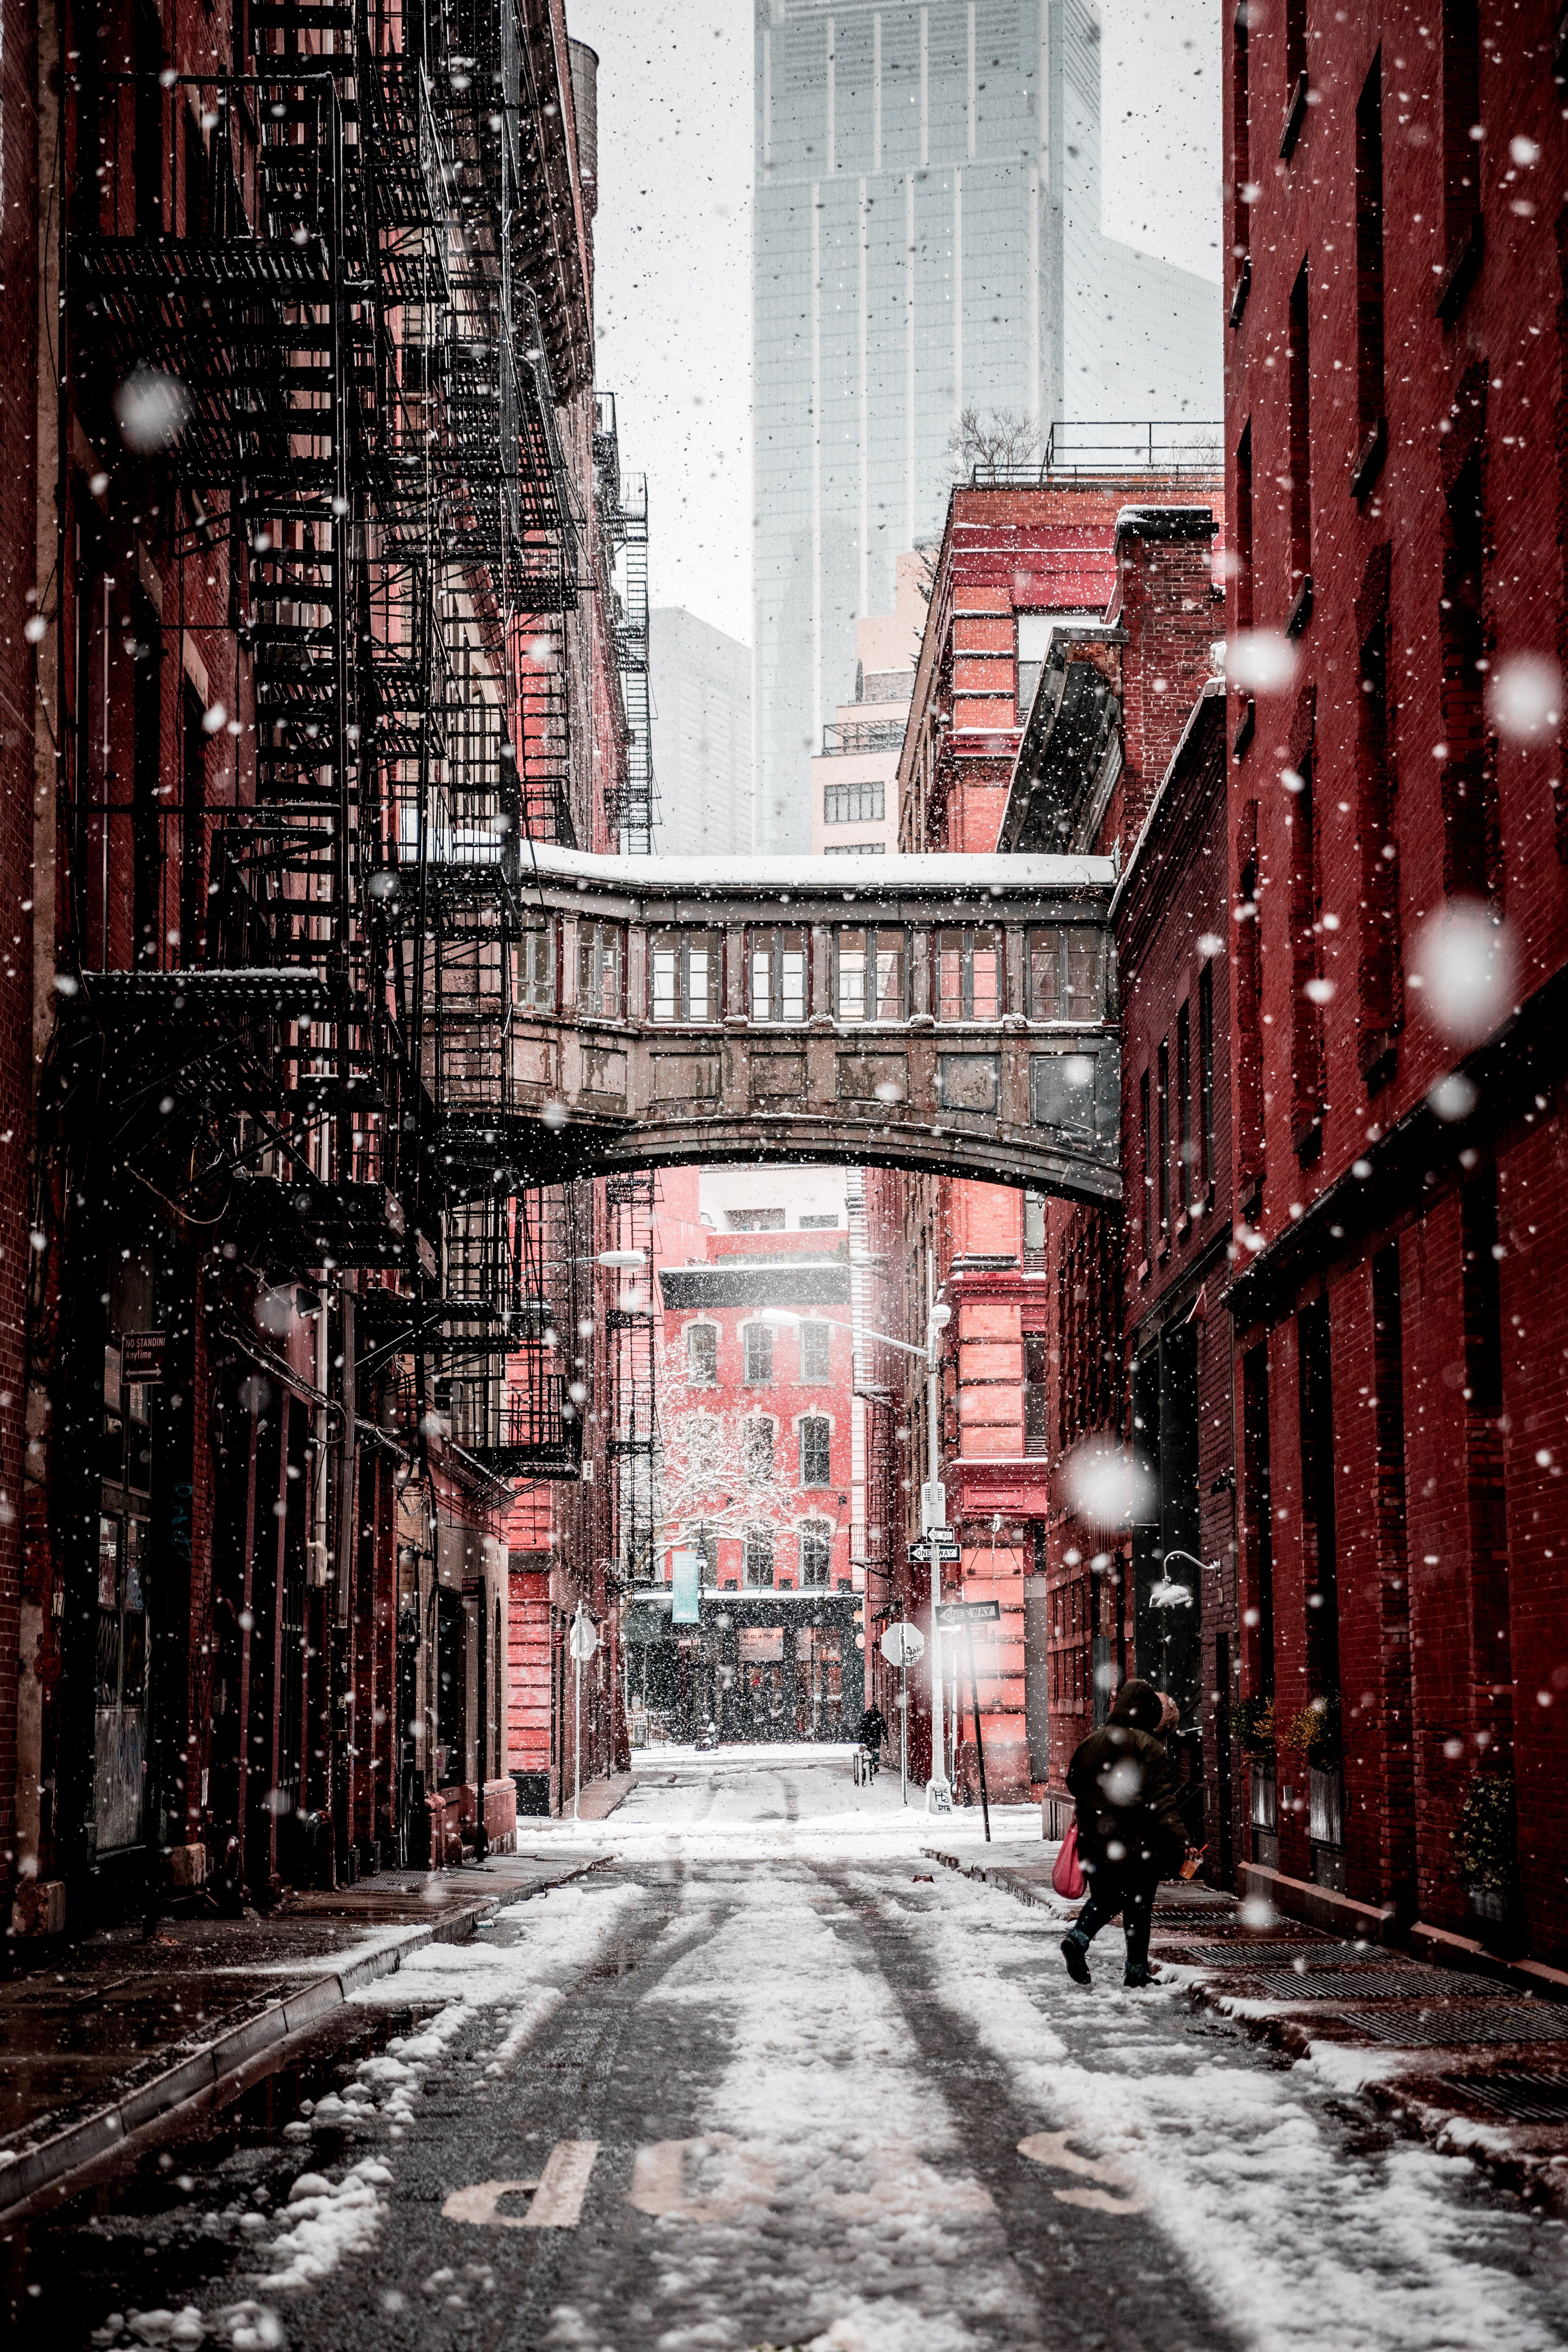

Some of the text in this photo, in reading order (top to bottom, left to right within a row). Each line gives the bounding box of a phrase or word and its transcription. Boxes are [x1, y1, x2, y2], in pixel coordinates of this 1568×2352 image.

[126, 1339, 134, 1348] NO
[126, 1350, 151, 1361] Anytime
[946, 1607, 991, 1619] ONE WAY
